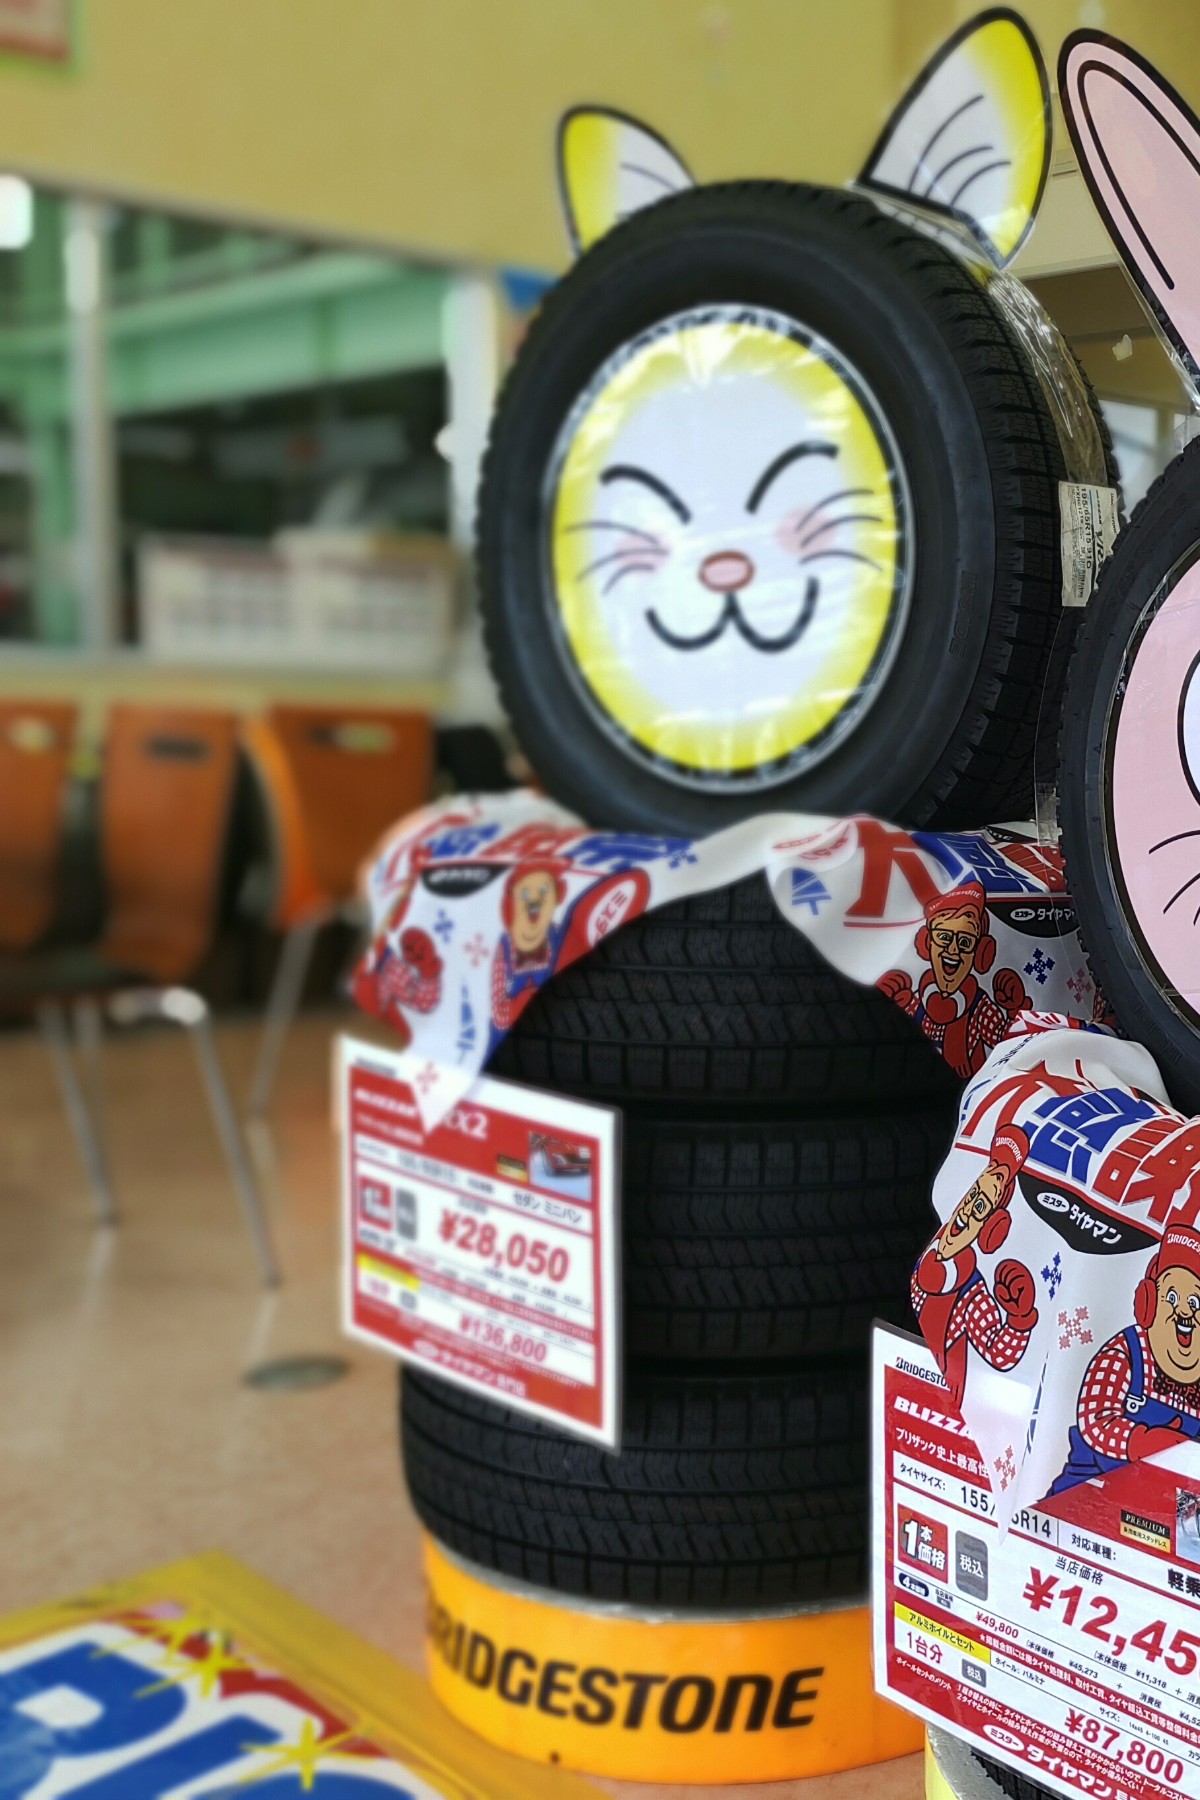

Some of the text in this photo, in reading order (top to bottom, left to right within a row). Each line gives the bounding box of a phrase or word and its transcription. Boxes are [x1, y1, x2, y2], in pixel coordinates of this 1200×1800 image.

[1037, 908, 1075, 920] タイヤマ
[1042, 1194, 1122, 1245] ミスター タイヤマン
[438, 1207, 570, 1283] ¥28,050
[459, 1314, 547, 1363] ¥136,800
[895, 1356, 952, 1392] BRIDGESTO
[893, 1396, 976, 1440] BLIZZA
[1125, 1514, 1166, 1535] PREMIUM
[918, 1542, 946, 1571] 価格
[960, 1554, 984, 1579] 税込
[1055, 1555, 1104, 1586] 当店価格
[909, 1612, 975, 1652] アルミホイルとセット
[975, 1610, 1019, 1639] ¥49,800
[907, 1631, 943, 1665] 1台分
[966, 1666, 983, 1683] 税込
[1069, 1660, 1098, 1679] ¥45,273
[1135, 1670, 1167, 1689] ¥11,318
[1064, 1707, 1184, 1784] ¥87,800
[989, 1727, 1112, 1798] ミスター タイヤマン
